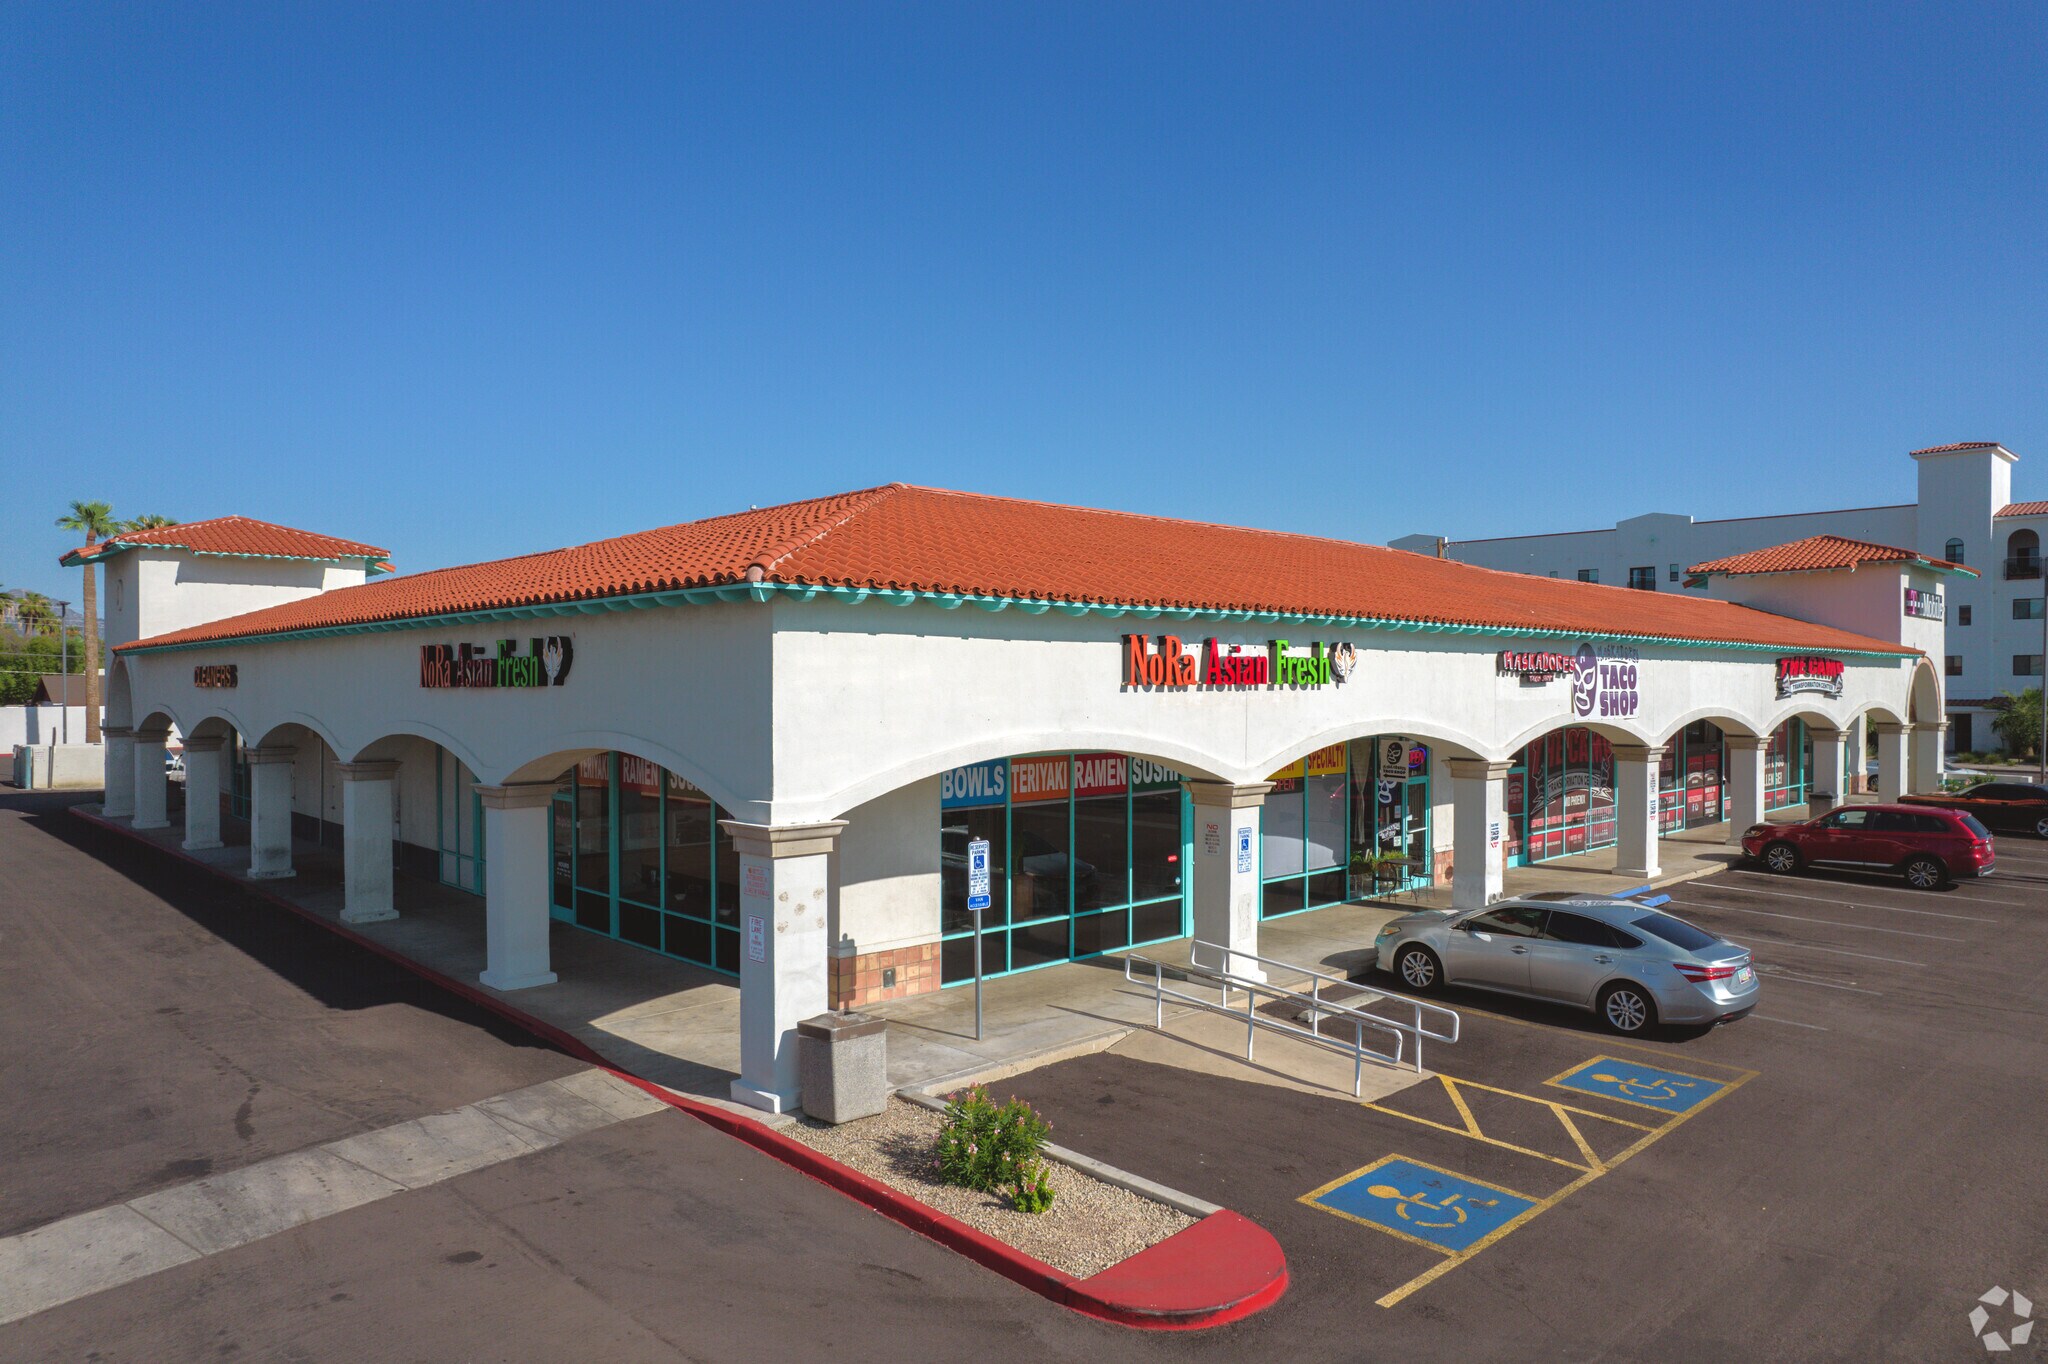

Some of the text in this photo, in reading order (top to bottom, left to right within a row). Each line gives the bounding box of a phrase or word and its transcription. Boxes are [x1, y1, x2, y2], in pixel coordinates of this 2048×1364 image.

[419, 638, 539, 688] NoRa Asian Fresh
[1128, 634, 1330, 686] NoRa Asian Fresh
[1503, 650, 1576, 674] MASKADORES
[1780, 657, 1845, 679] THE CAMP
[193, 665, 236, 688] CLEANERS
[1600, 664, 1637, 690] TACO
[1600, 690, 1638, 717] SHOP
[1308, 744, 1346, 770] SPECIALTY
[623, 756, 659, 786] RAMEN
[942, 765, 1005, 800] BOWLS
[1011, 761, 1068, 794] TERIYAKI
[1074, 758, 1127, 789] RAMEN
[1274, 778, 1295, 791] OPEN
[751, 917, 763, 927] FIRE
[751, 925, 762, 935] LANE
